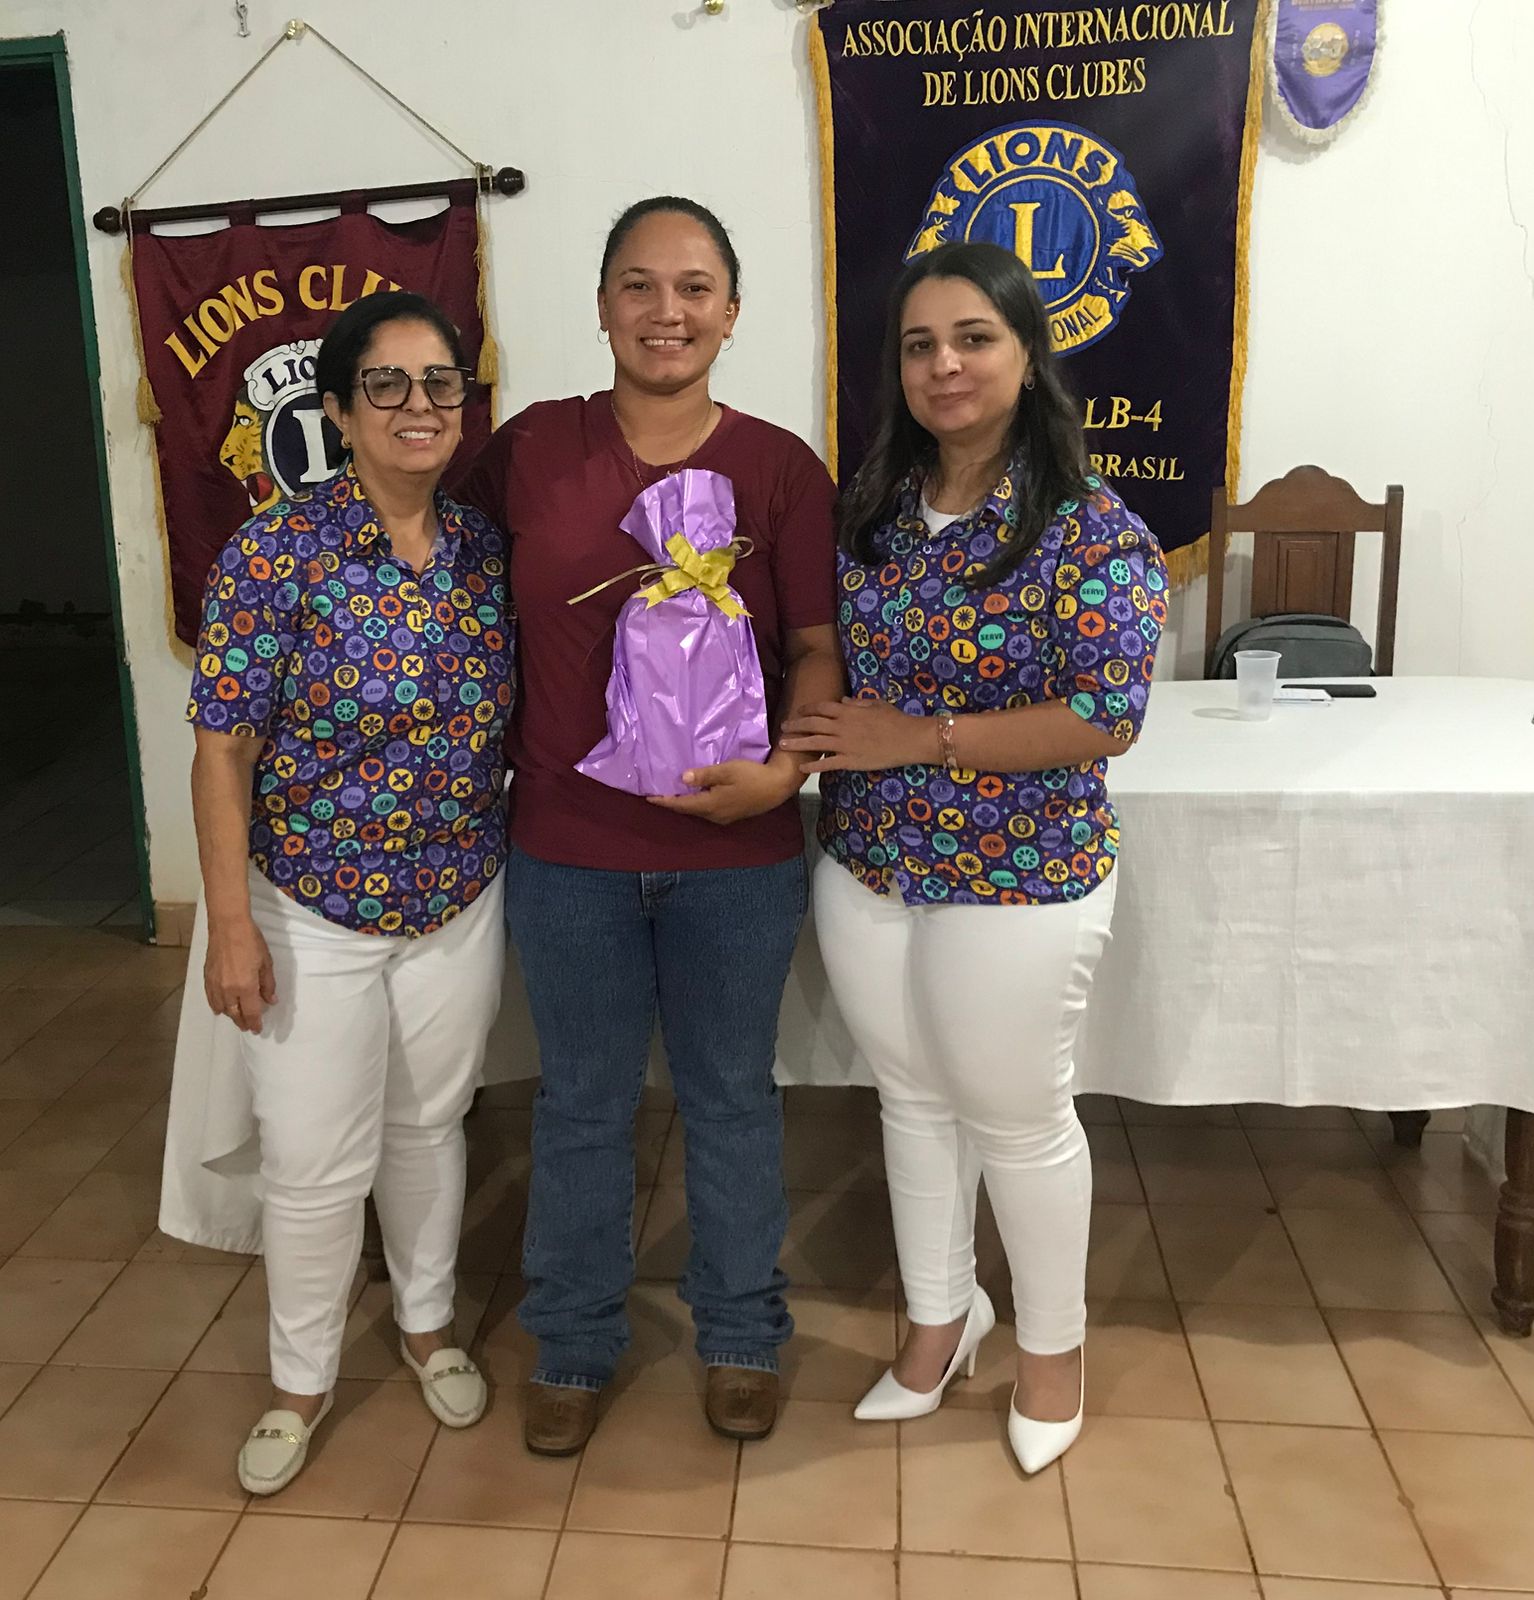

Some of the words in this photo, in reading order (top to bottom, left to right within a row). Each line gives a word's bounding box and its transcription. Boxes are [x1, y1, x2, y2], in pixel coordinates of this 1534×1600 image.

[841, 9, 1007, 62] ASSOCIAÇÃO
[1013, 0, 1235, 50] INTERNACIONAL
[922, 71, 957, 106] DE
[963, 66, 1040, 105] LIONS
[1046, 56, 1147, 100] CLUBES
[957, 131, 1110, 189] LIONS
[1008, 202, 1066, 279] L
[163, 269, 285, 380] LIONS
[1052, 305, 1103, 343] ONAL
[262, 355, 319, 395] LIO
[1082, 396, 1163, 432] LB-4
[1088, 453, 1185, 481] BRASIL
[1081, 587, 1105, 597] SERVE
[1061, 598, 1070, 614] L
[412, 613, 422, 628] L
[465, 620, 477, 633] L
[980, 632, 1003, 641] SERVE
[958, 643, 970, 659] L
[204, 657, 216, 674] L
[366, 687, 384, 695] LEAD
[414, 728, 426, 742] L
